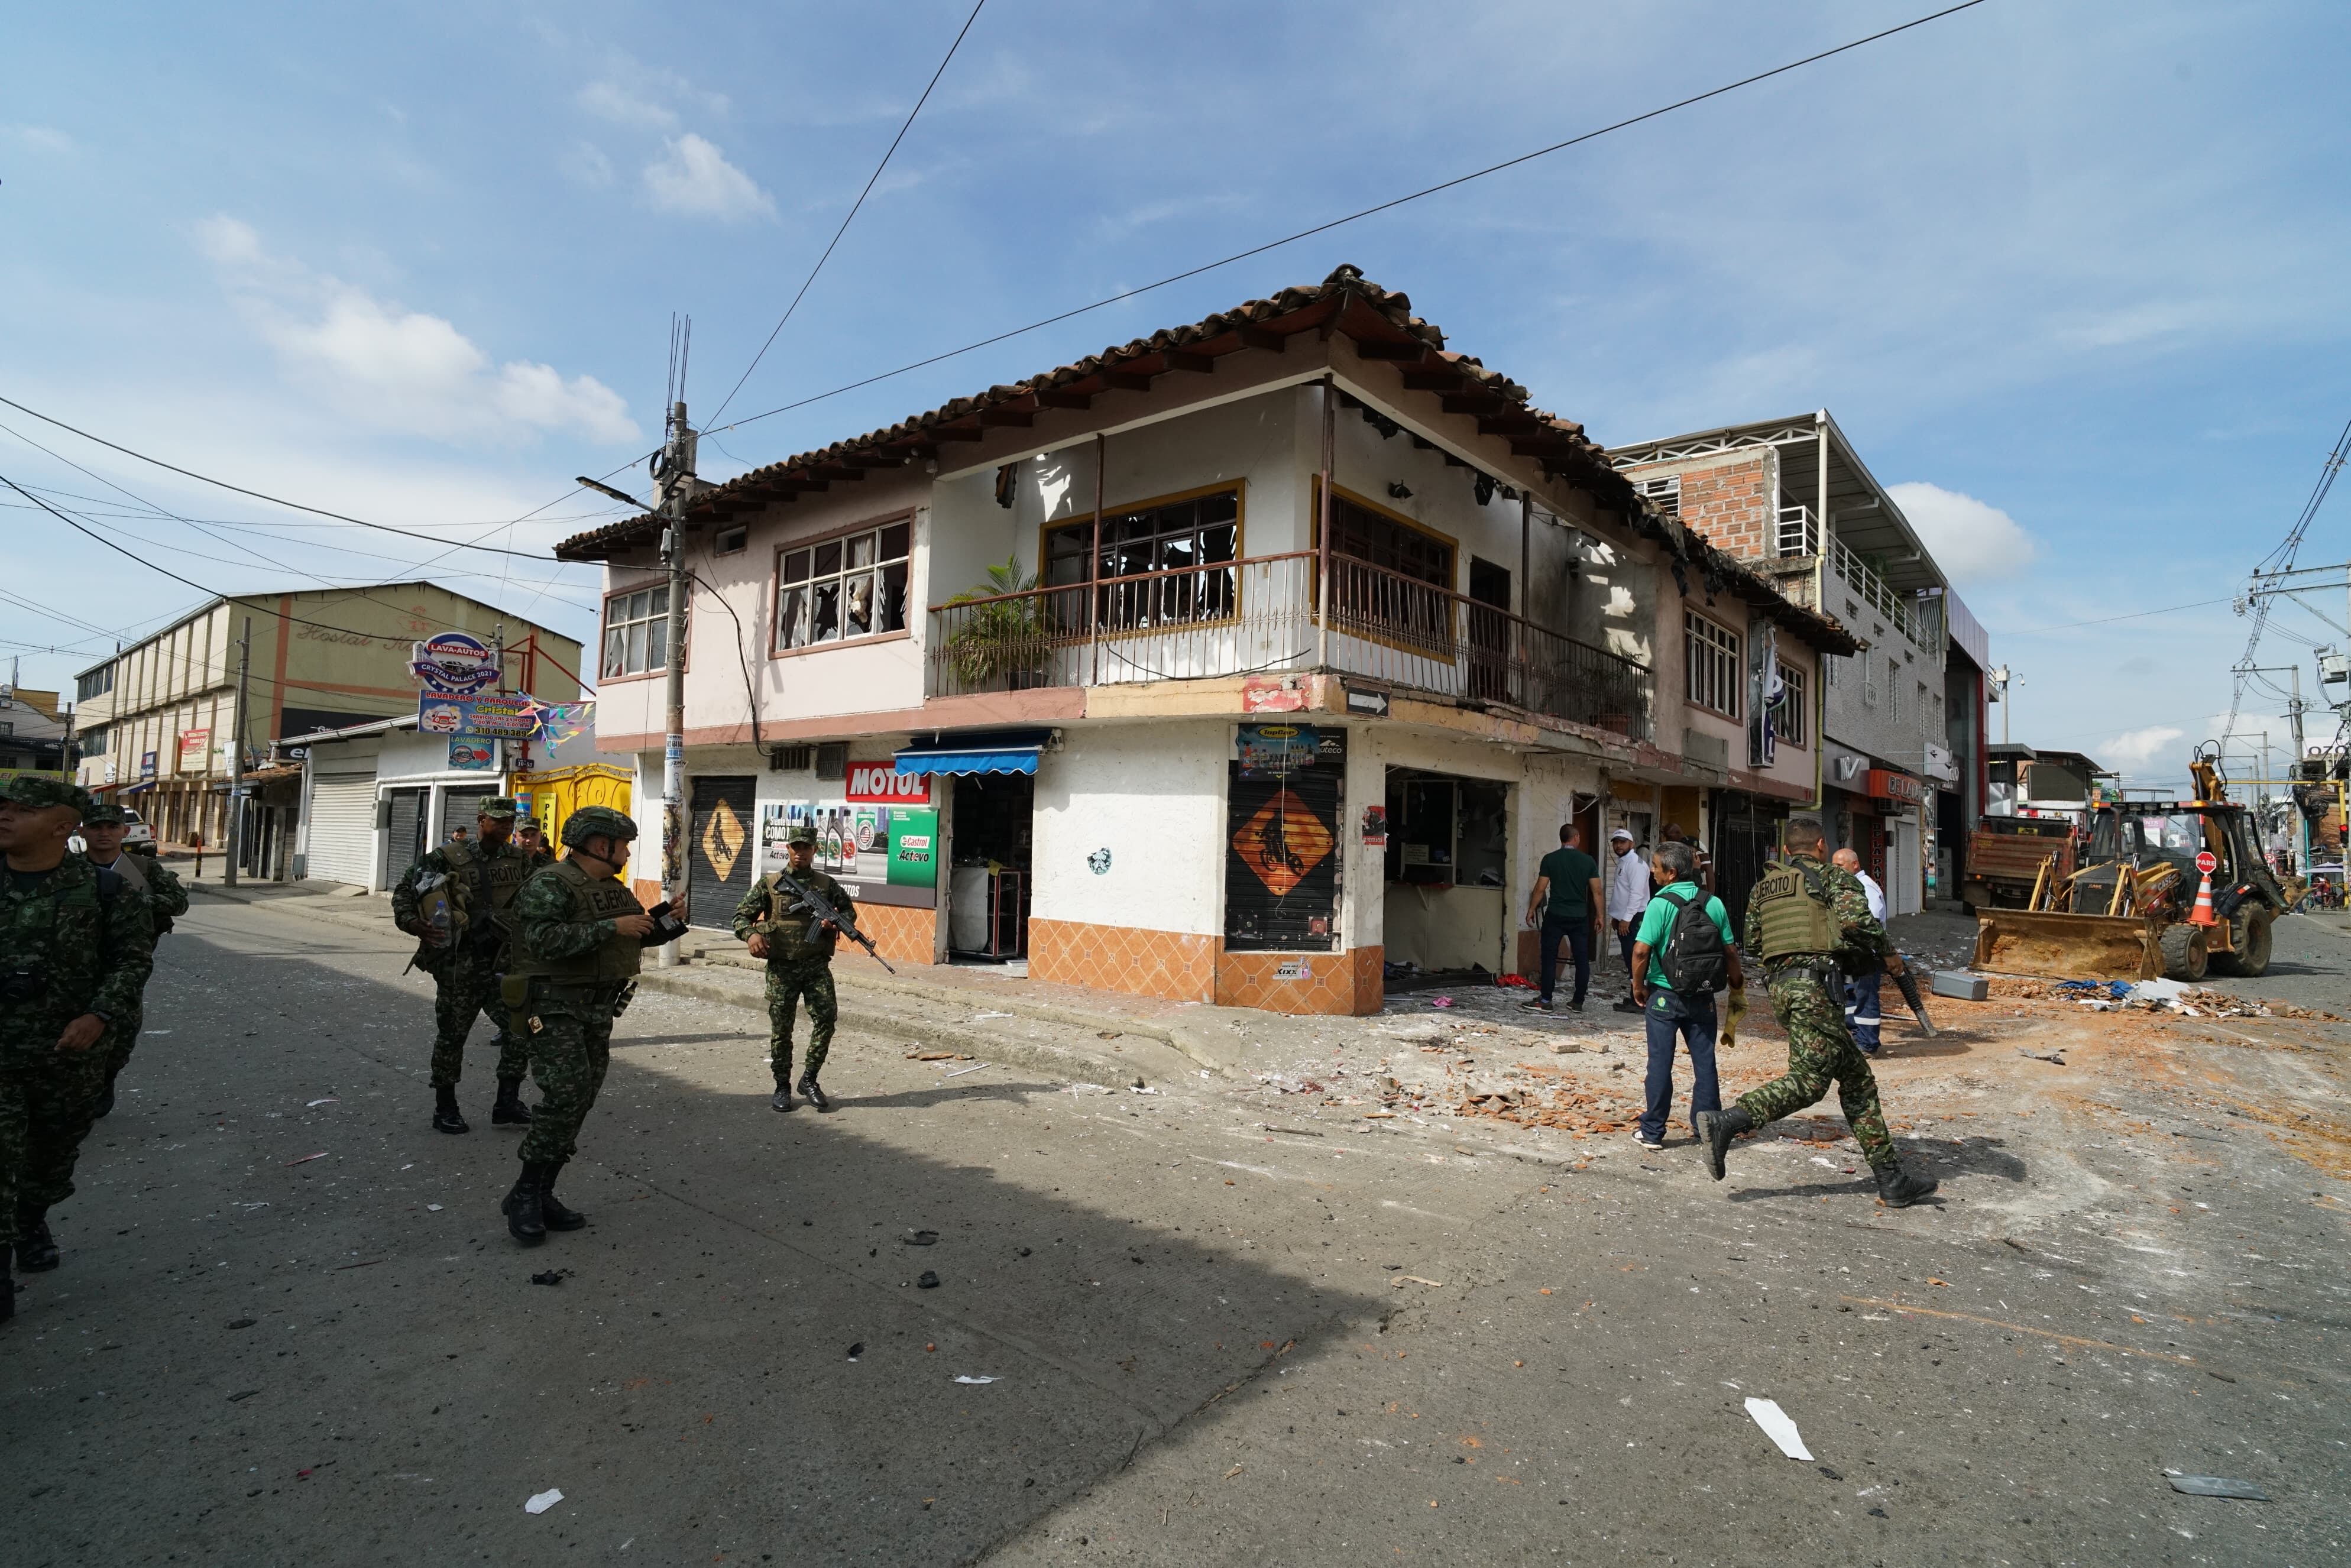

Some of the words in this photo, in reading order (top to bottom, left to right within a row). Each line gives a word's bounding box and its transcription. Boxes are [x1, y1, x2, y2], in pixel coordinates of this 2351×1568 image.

[422, 663, 449, 679] CRYSTAL
[451, 672, 476, 682] PALACE
[425, 691, 473, 702] LAVADERO
[492, 728, 509, 736] 489
[451, 736, 491, 744] LAVADERO
[850, 767, 924, 796] MOTUL
[1889, 775, 1902, 795] DE
[770, 817, 786, 826] Siente
[766, 827, 786, 840] COMO
[907, 837, 927, 847] Castrol
[2158, 875, 2173, 890] CASE
[592, 887, 638, 912] EJERCIT
